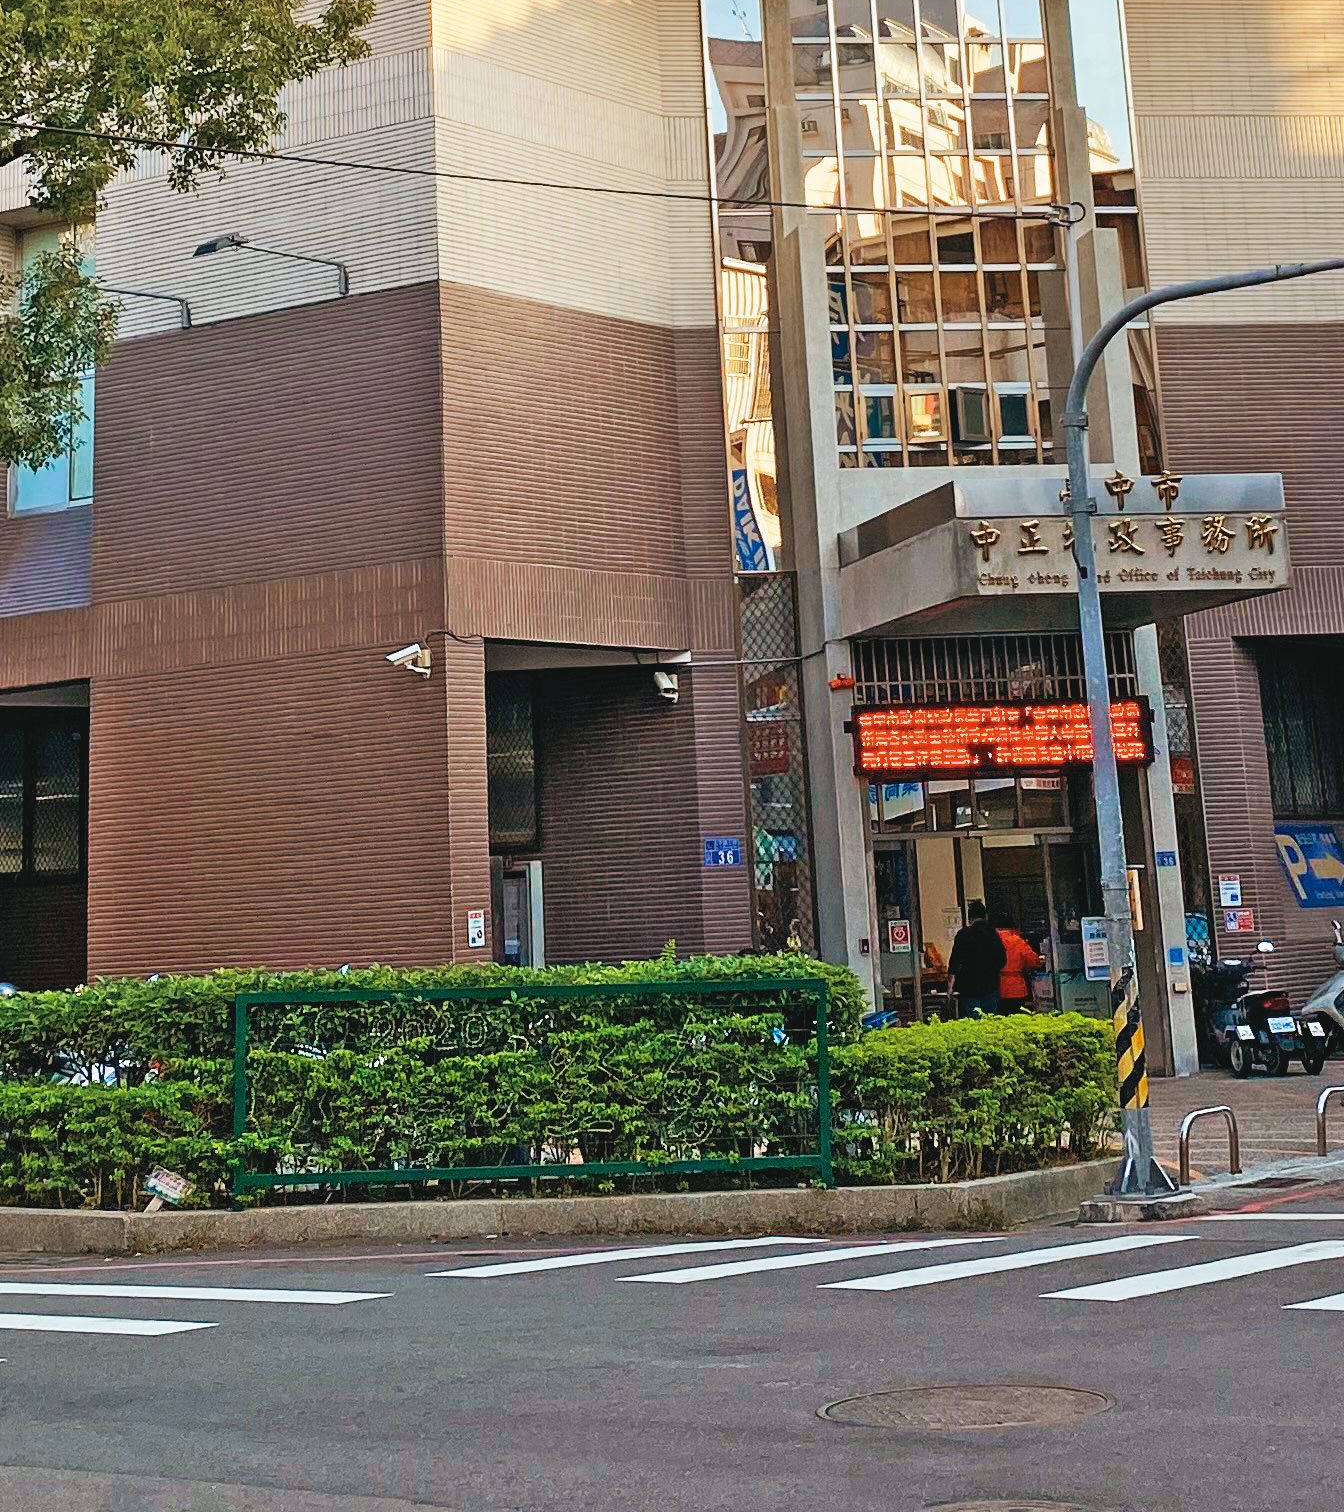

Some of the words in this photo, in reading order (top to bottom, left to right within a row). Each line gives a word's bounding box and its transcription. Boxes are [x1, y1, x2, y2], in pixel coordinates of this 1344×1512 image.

[970, 514, 1279, 562] 中正政事務所
[1117, 567, 1158, 583] Office
[1166, 566, 1180, 581] of
[1186, 567, 1243, 583] Taichung
[1248, 567, 1276, 584] City
[718, 850, 734, 865] 36
[1275, 835, 1308, 900] P
